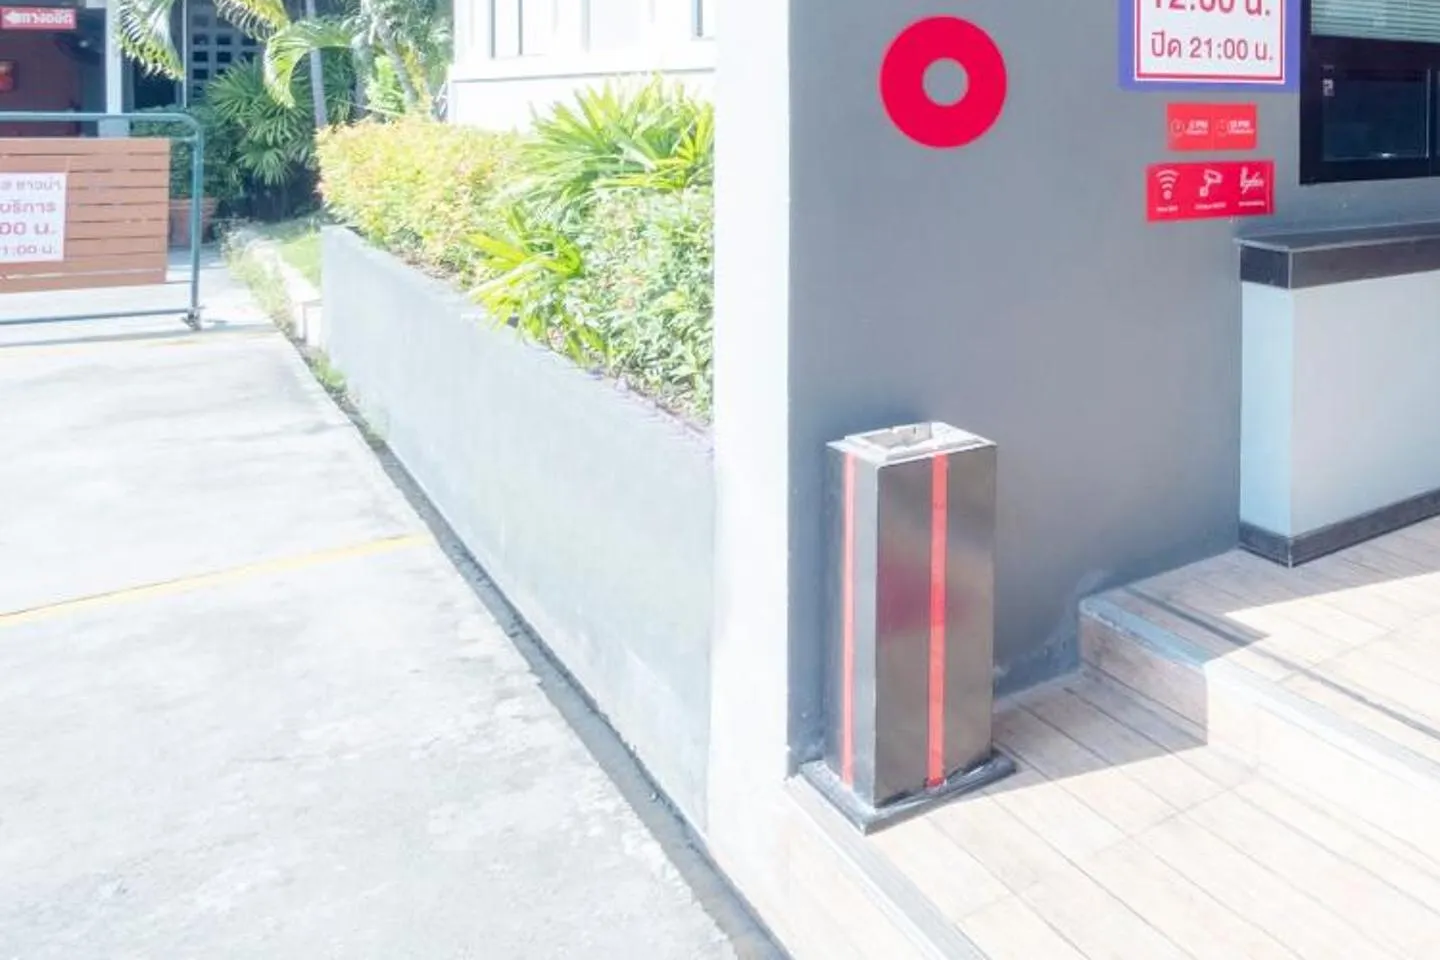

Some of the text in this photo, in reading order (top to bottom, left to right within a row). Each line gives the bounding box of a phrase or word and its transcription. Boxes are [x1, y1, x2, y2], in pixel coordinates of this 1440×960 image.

[1151, 29, 1274, 61] ปิด 21:00 น.
